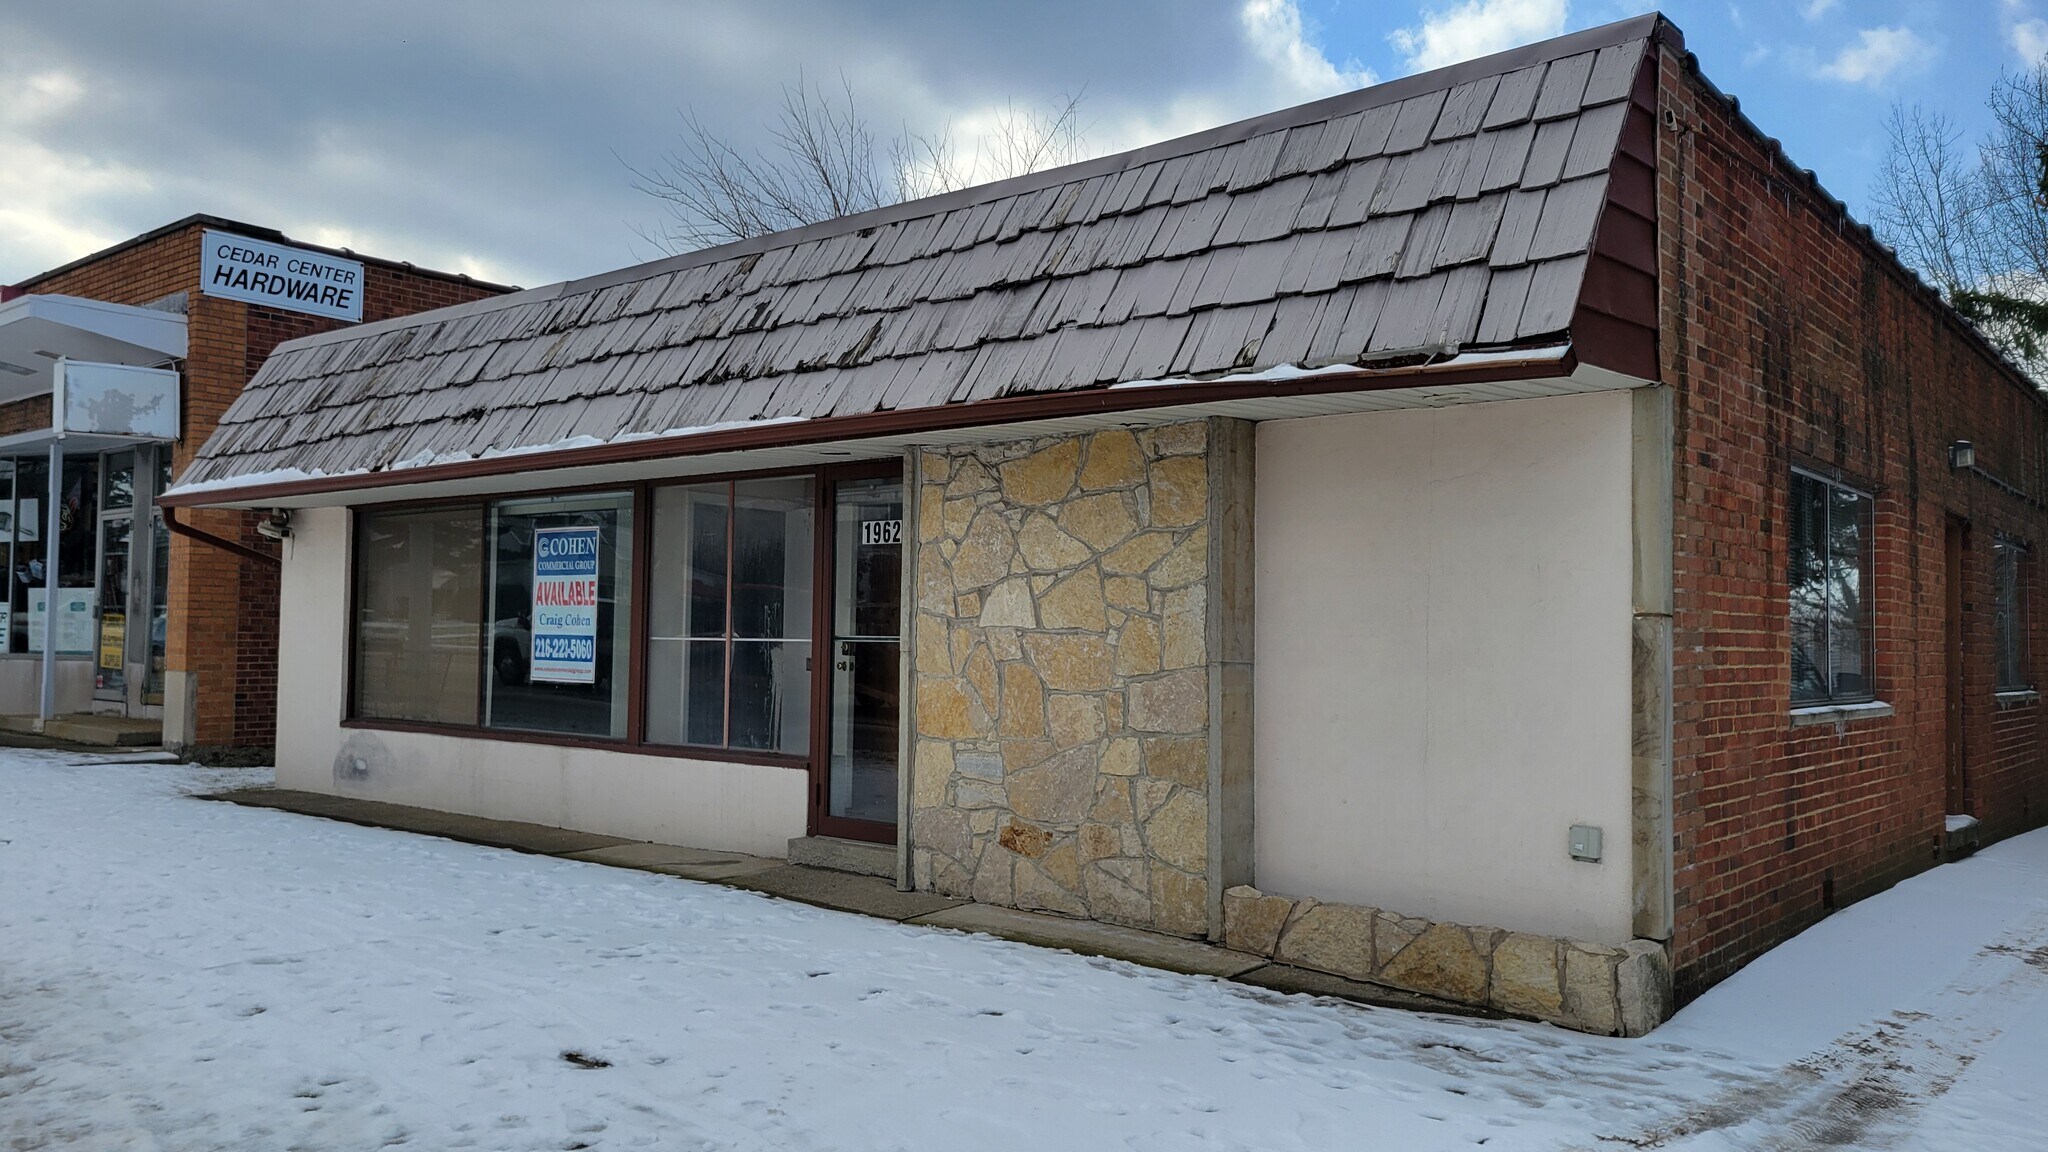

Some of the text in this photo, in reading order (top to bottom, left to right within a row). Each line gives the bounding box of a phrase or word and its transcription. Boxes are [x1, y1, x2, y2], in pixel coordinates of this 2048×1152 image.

[217, 245, 356, 285] CEDAR CENTER
[213, 265, 354, 309] HARDWARE
[864, 521, 901, 544] 1962
[550, 536, 596, 556] COHEN
[538, 560, 595, 571] COMMERCIAL GROUP
[536, 581, 595, 606] AVAILABLE
[539, 613, 591, 629] Craig Cohen
